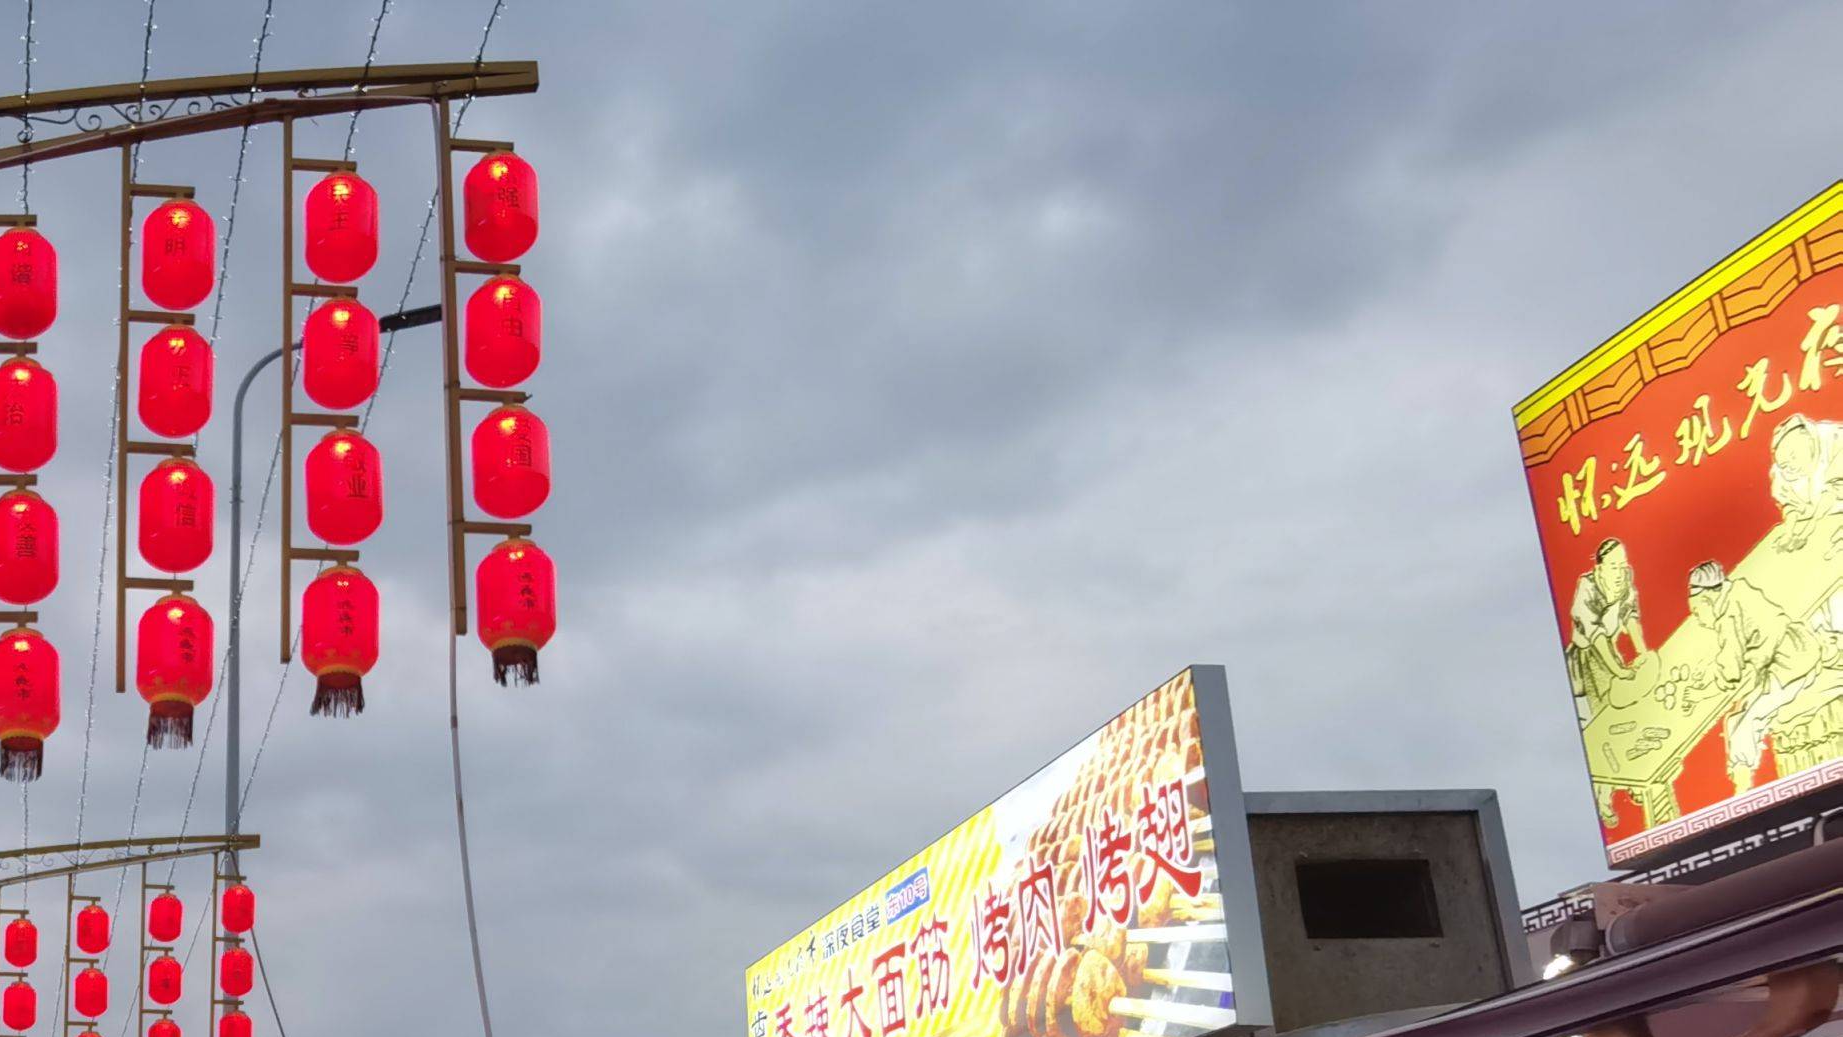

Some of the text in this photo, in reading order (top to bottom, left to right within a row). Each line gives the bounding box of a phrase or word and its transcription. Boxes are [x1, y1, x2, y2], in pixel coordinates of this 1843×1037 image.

[822, 904, 881, 960] 深夜食堂
[886, 878, 930, 920] 东10号
[972, 856, 1065, 991] 烤肉
[1082, 778, 1203, 934] 烤翅
